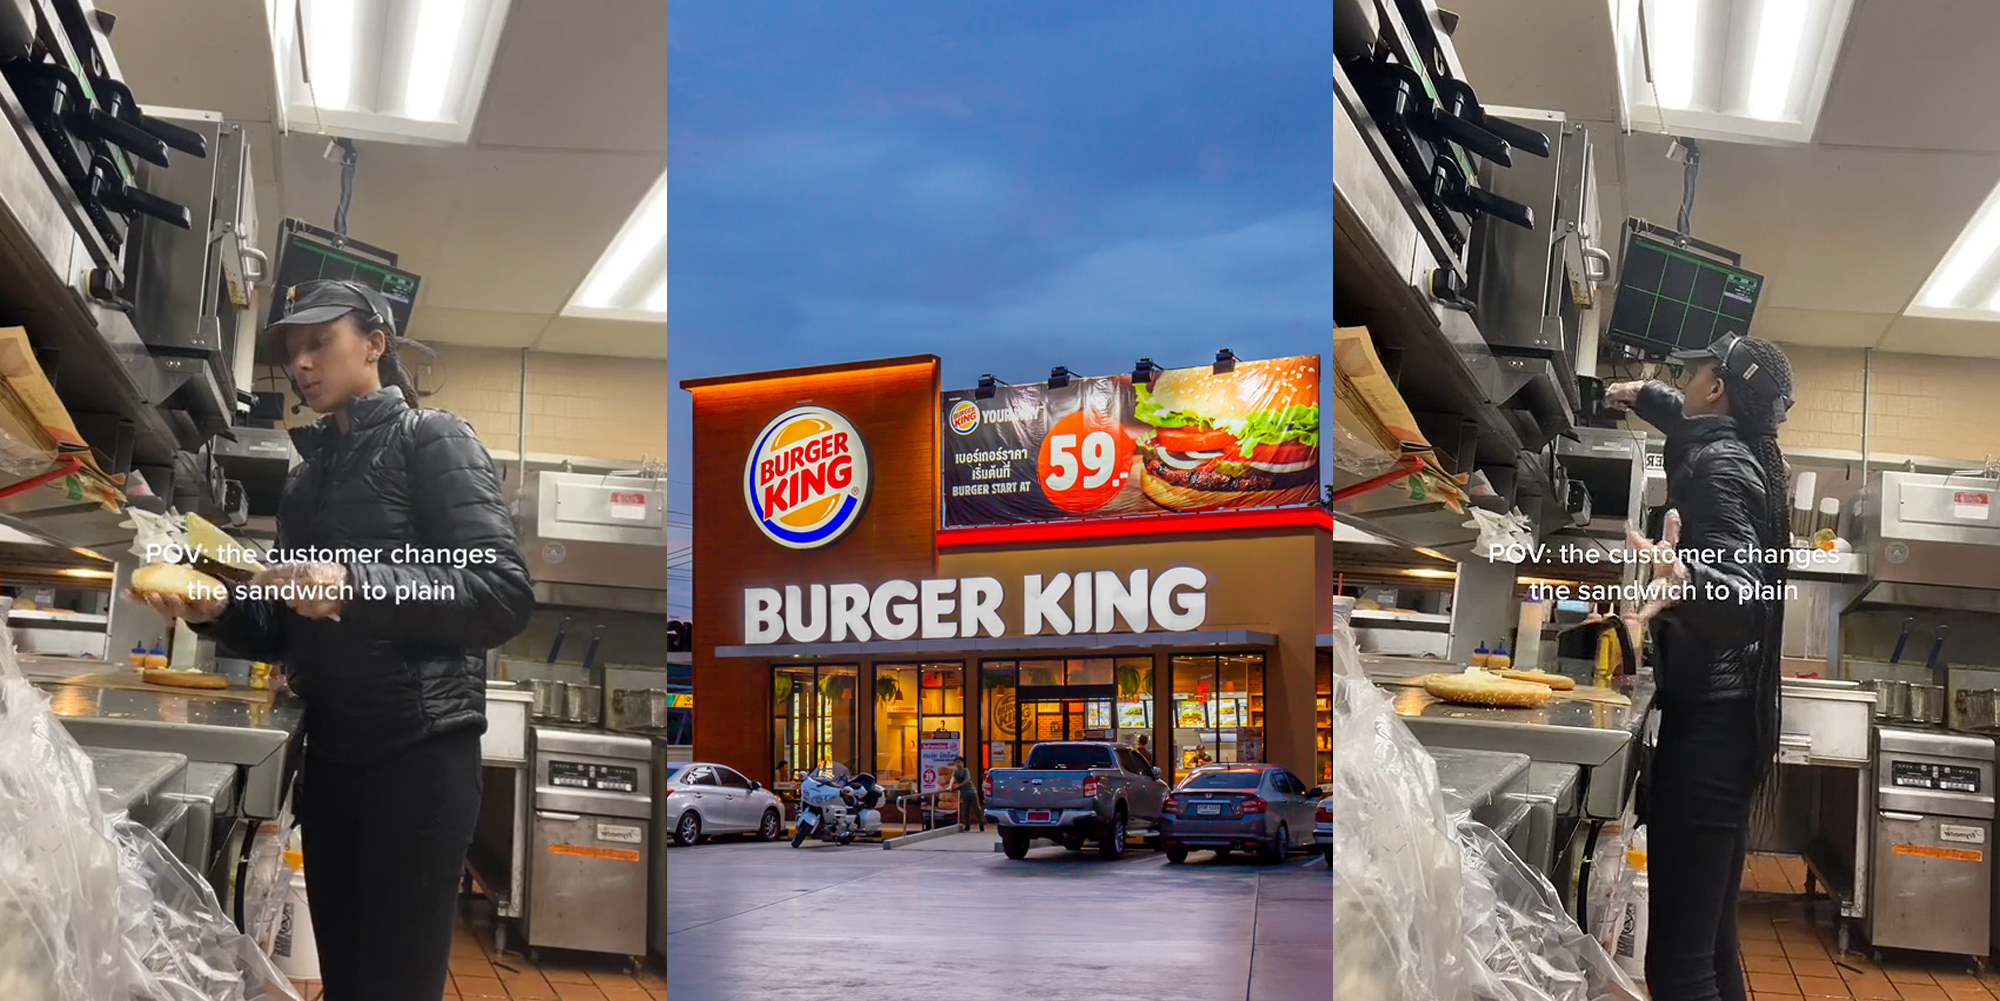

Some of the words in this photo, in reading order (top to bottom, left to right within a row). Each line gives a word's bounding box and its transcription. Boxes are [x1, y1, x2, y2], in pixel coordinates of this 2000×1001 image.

[953, 406, 975, 419] BURGER
[955, 411, 976, 428] KING
[760, 431, 849, 487] BURGER
[955, 447, 1028, 463] เบอร์เกอร์ราคา
[764, 455, 852, 520] KING
[952, 483, 990, 497] BURGER
[991, 482, 1017, 495] START
[1019, 481, 1031, 492] AT
[744, 576, 1006, 645] BURGER
[1023, 565, 1208, 636] KING
[999, 707, 1030, 727] KIG
